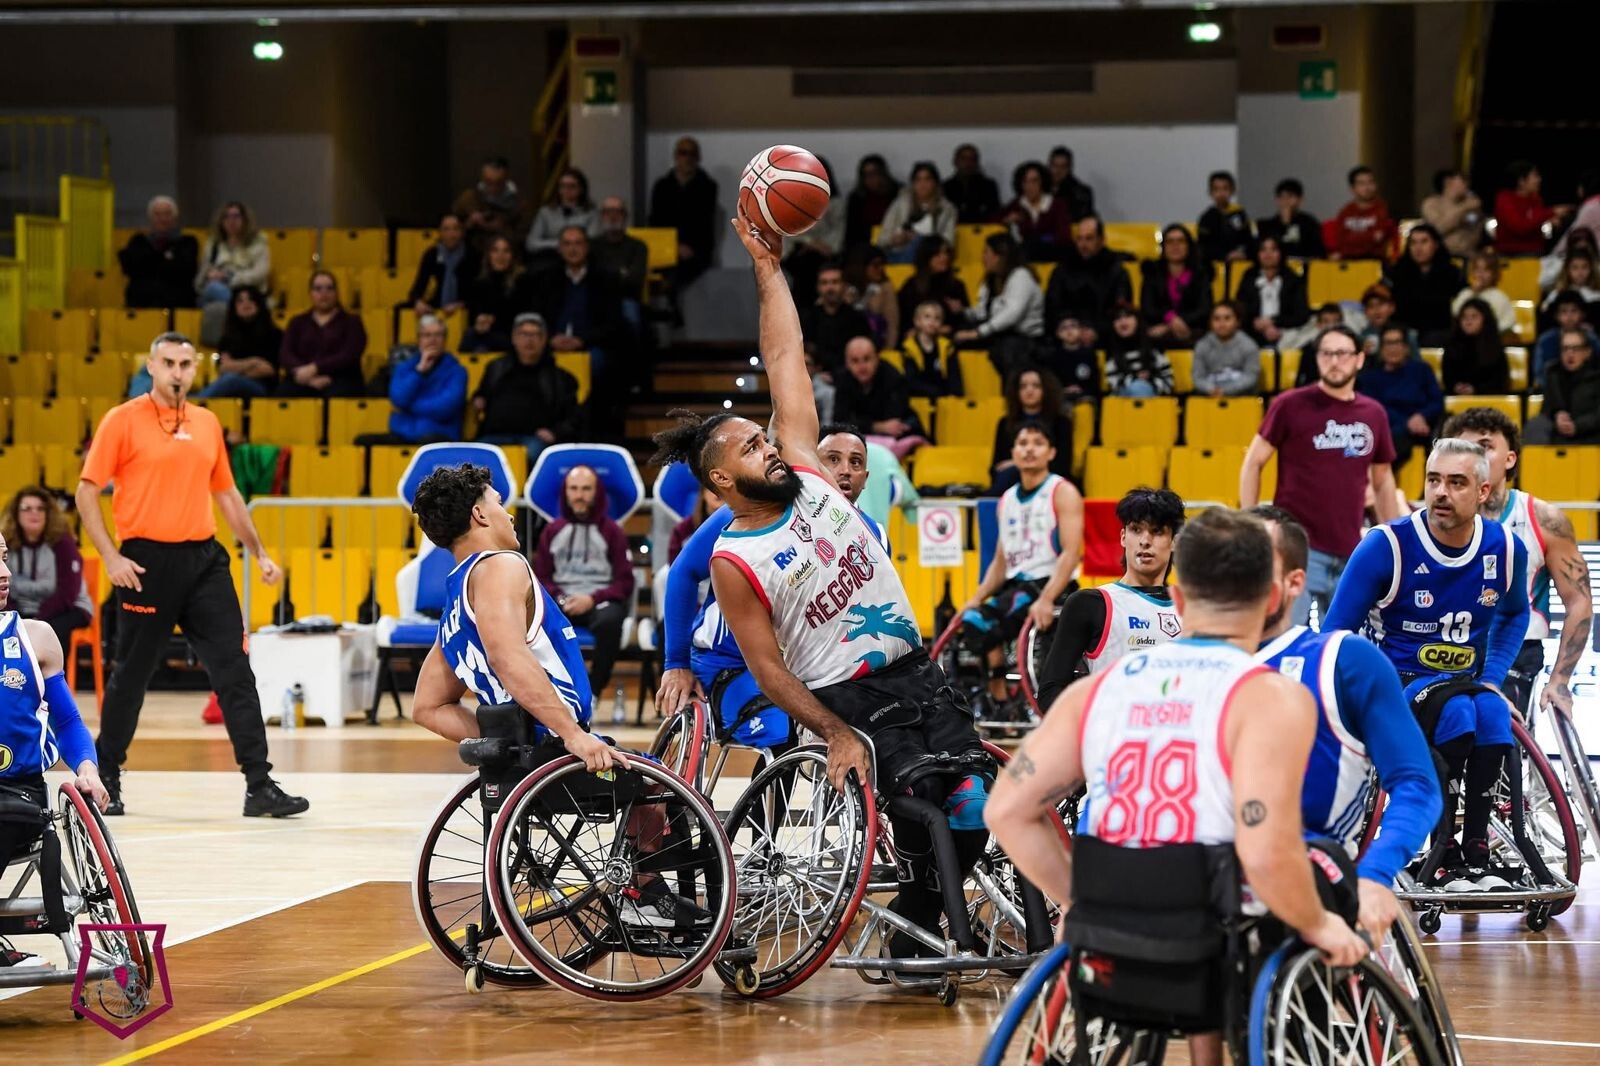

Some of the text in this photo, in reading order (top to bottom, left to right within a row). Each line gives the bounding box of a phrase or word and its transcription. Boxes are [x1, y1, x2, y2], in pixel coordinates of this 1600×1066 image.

[805, 544, 874, 630] REGGIO
[1414, 623, 1437, 631] CMB
[1439, 610, 1473, 644] 13
[1424, 648, 1472, 667] CRICH
[1096, 738, 1198, 849] 88
